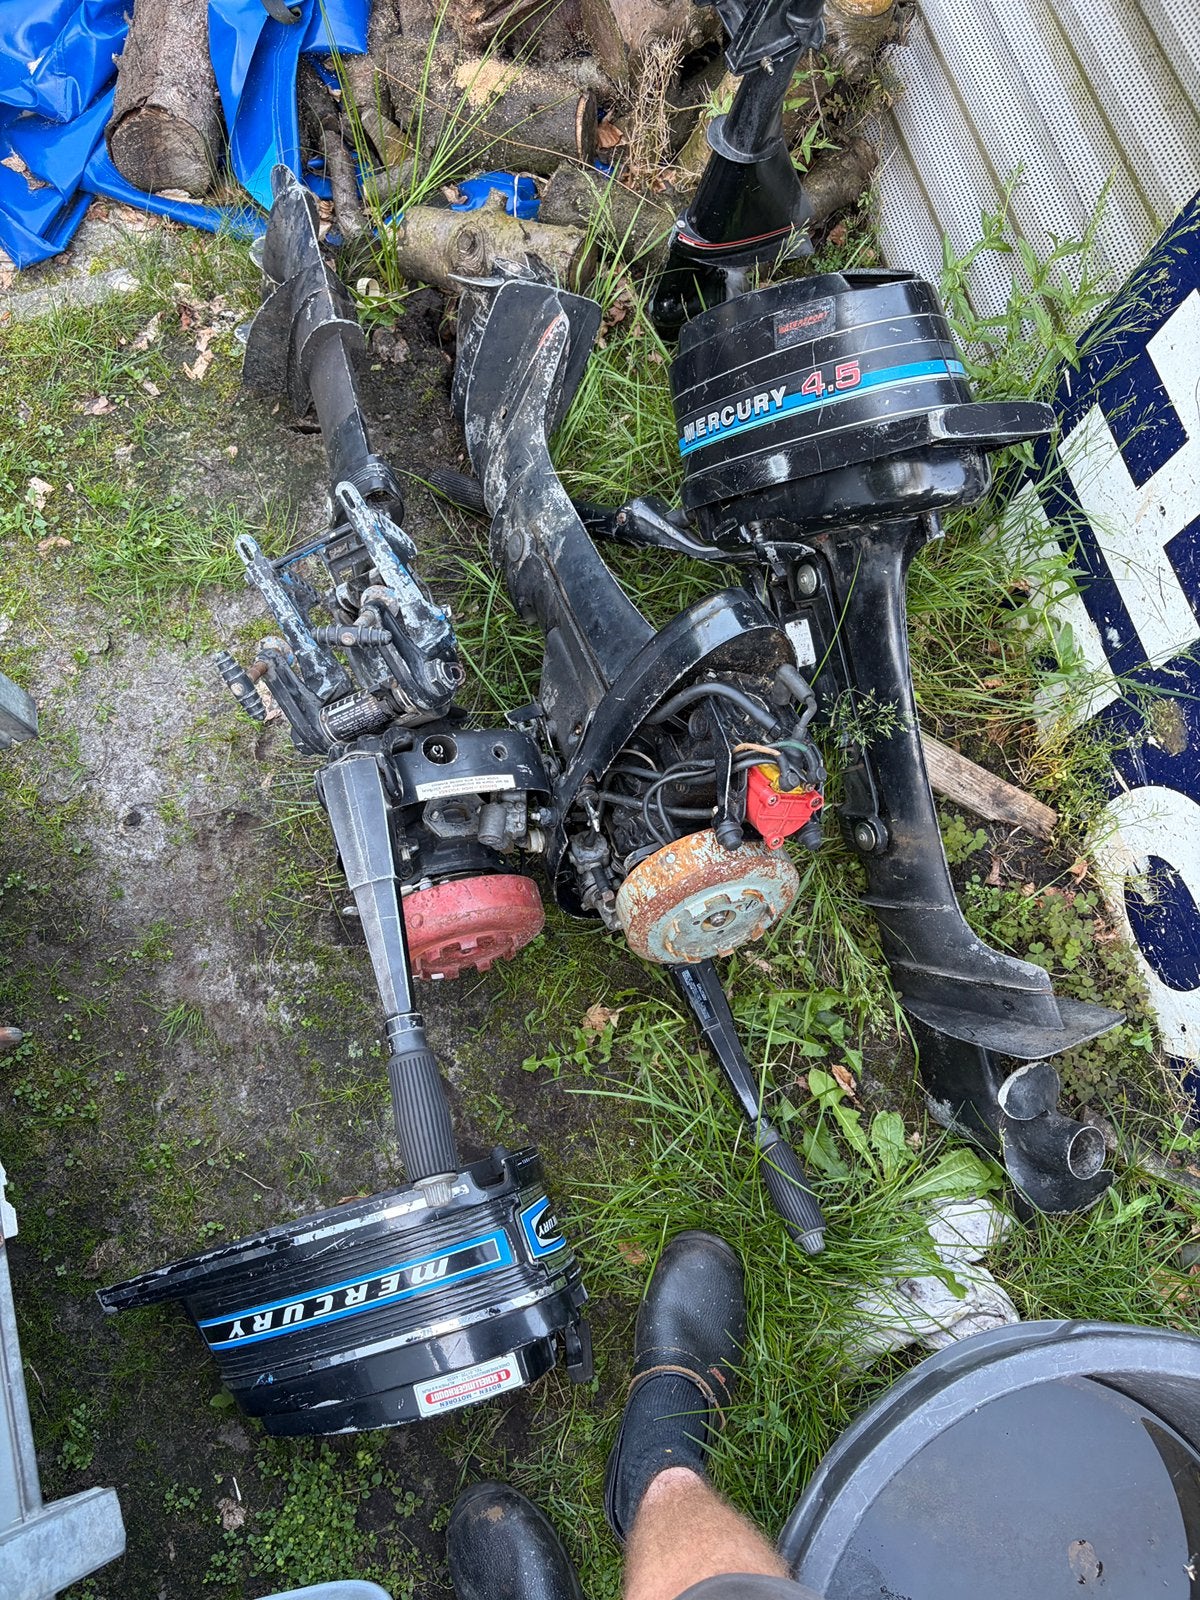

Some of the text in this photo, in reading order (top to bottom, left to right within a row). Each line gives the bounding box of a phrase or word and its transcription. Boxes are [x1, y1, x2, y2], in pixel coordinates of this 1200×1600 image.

[683, 360, 862, 445] MERCURY 4.5
[228, 1257, 450, 1339] MERCURY
[439, 1392, 472, 1408] MOTOREN
[479, 1383, 502, 1395] BOTEN
